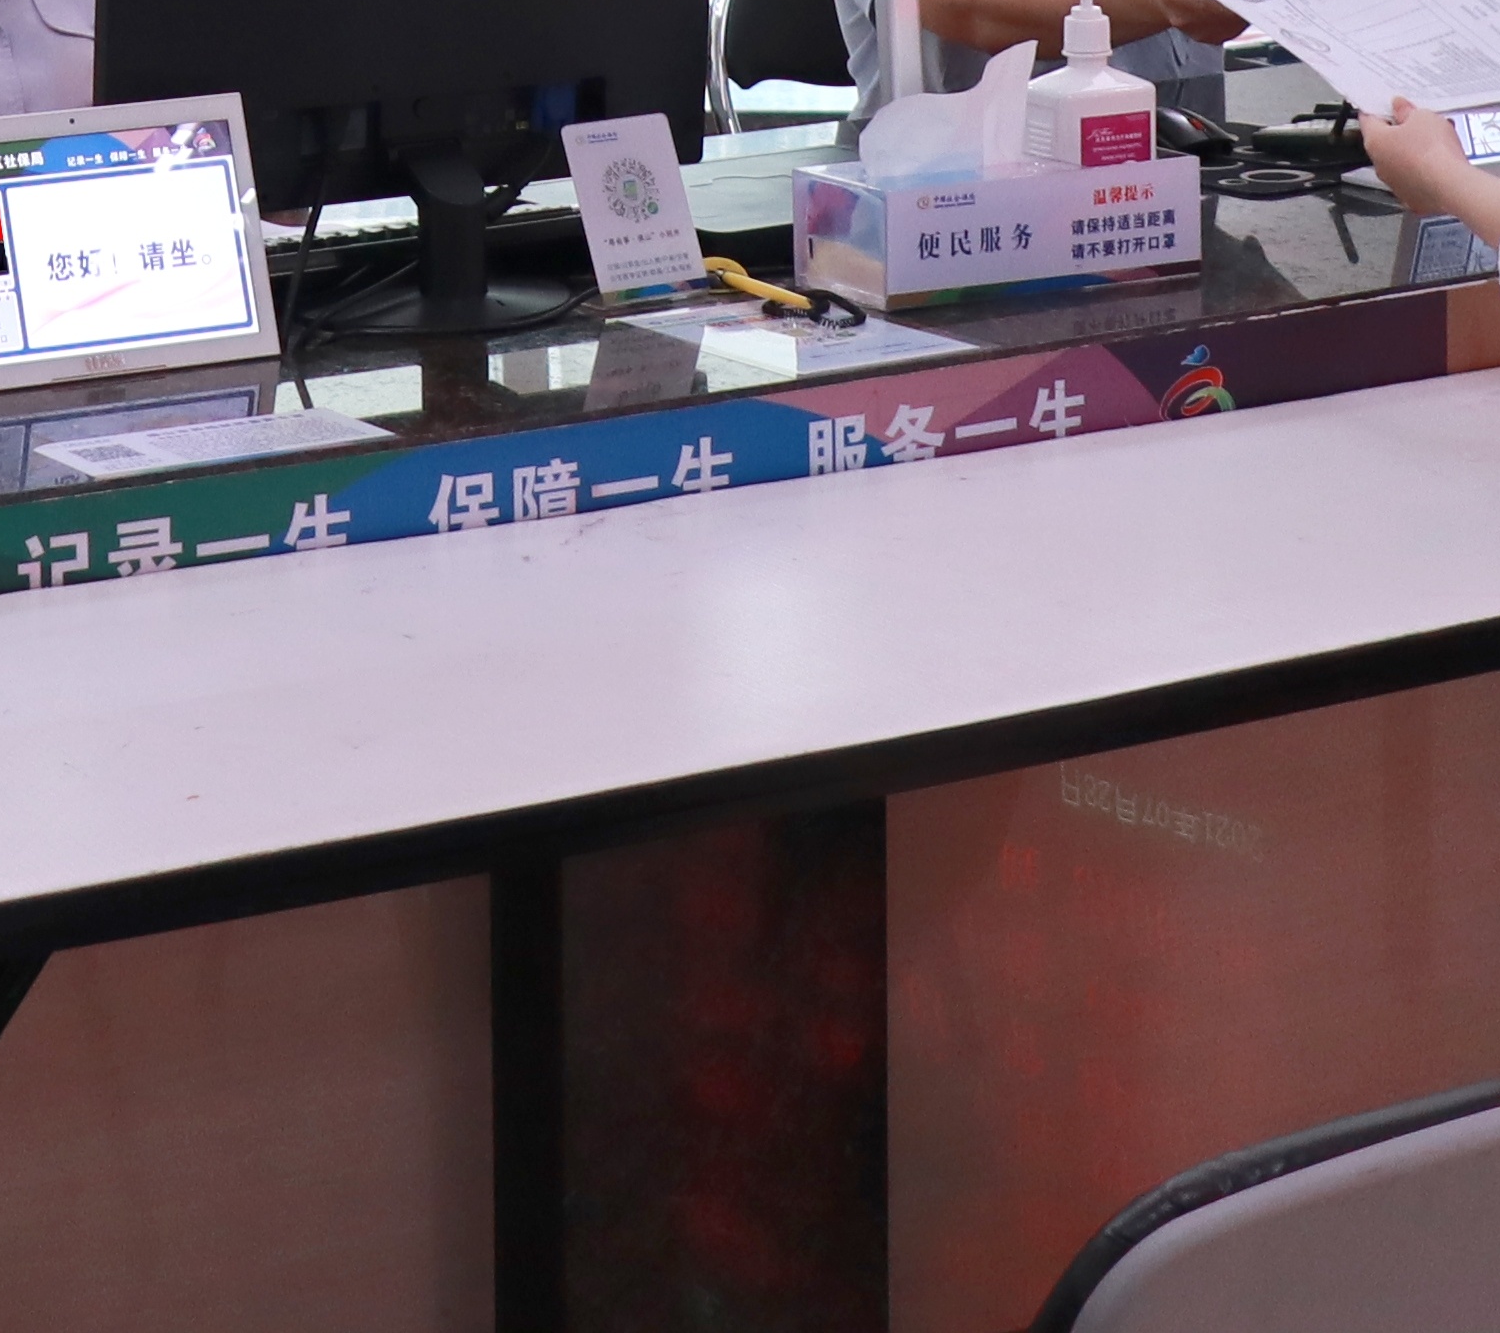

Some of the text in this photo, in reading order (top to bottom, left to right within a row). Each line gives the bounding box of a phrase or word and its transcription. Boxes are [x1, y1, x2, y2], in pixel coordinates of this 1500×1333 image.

[1092, 183, 1156, 206] 温馨提示
[917, 222, 1034, 261] 便民服务
[1071, 209, 1176, 236] 请保持适当距离
[1071, 232, 1176, 260] 请不要打开口罩
[808, 379, 1087, 476] 服务一生
[428, 437, 736, 532] 保障一生
[17, 495, 353, 590] 记录一生
